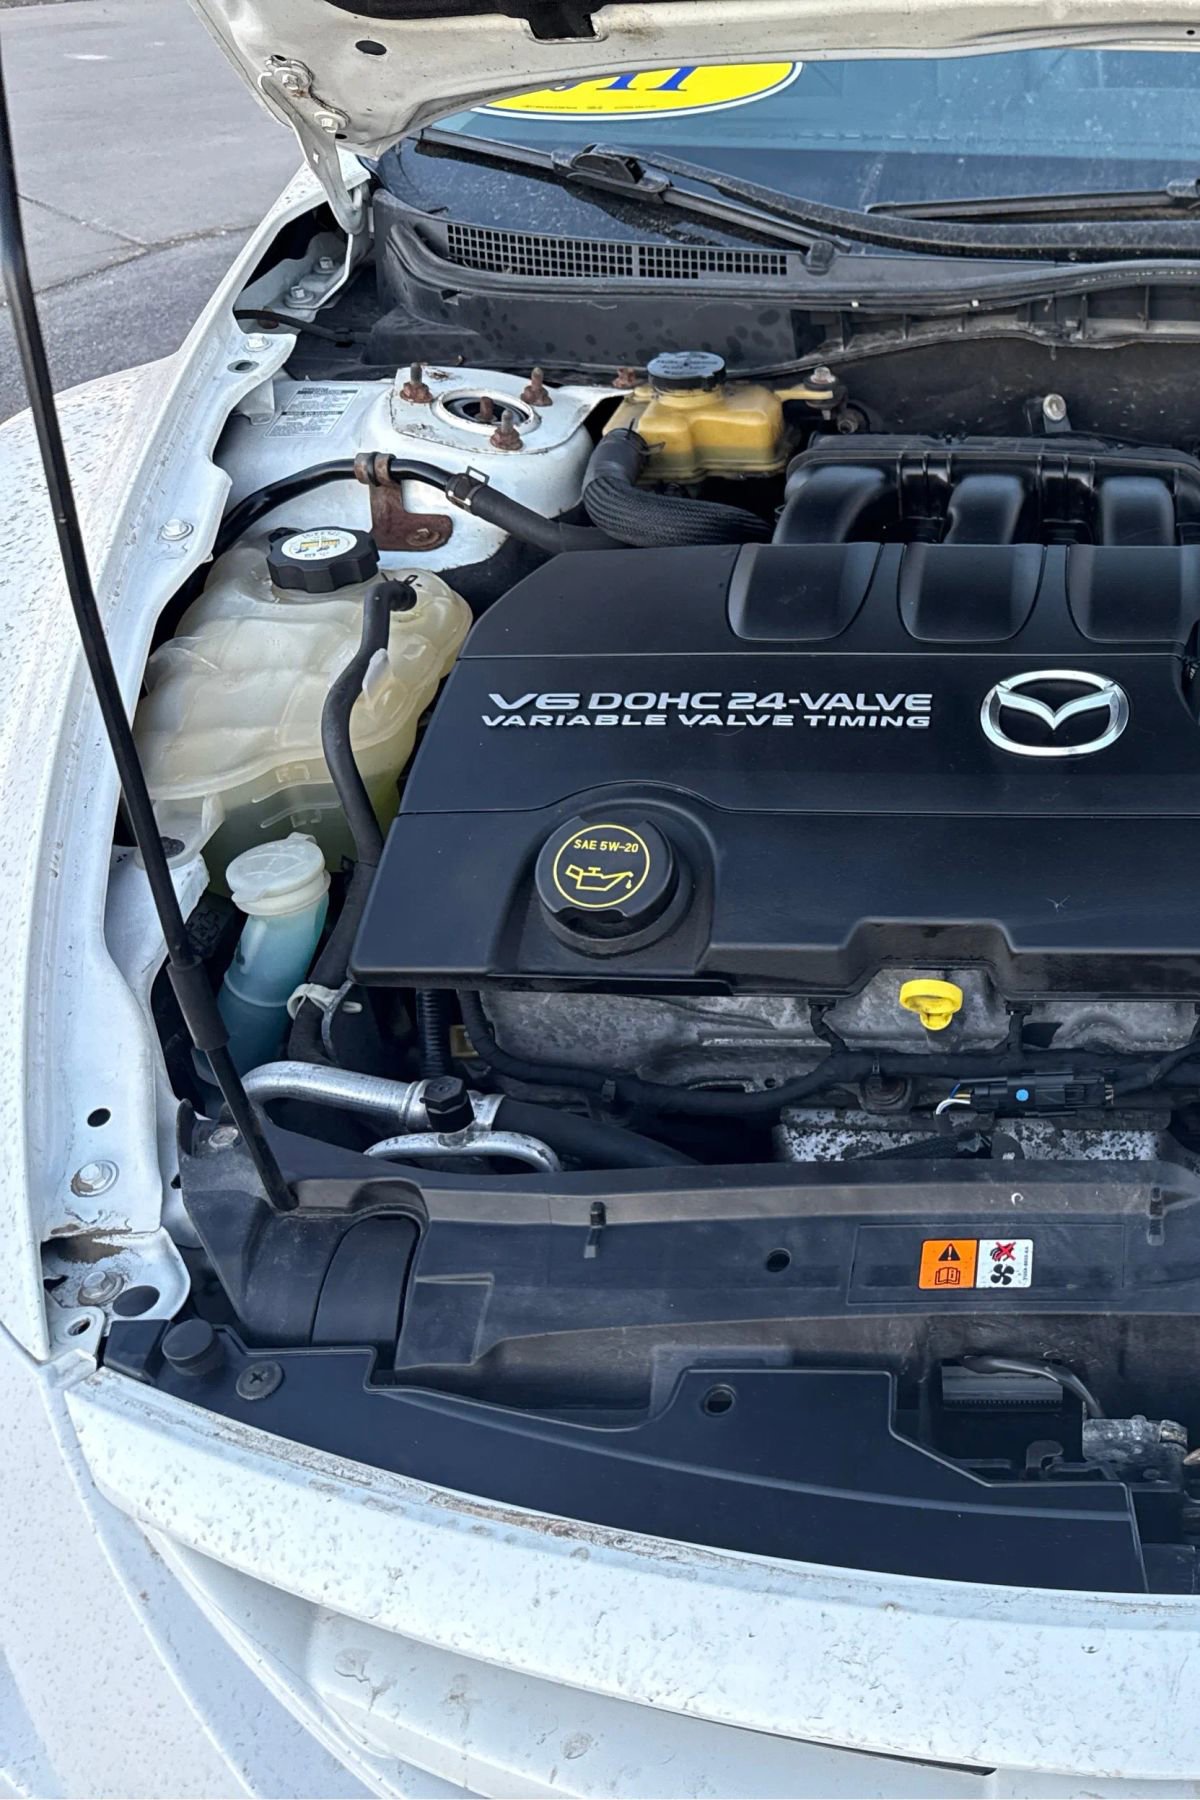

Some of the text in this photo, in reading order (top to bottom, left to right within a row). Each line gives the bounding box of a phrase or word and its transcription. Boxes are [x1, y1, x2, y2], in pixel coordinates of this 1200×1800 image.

[488, 692, 932, 711] V6 DOHC 24-VALVE
[481, 714, 931, 728] VARIABLE VALVE TIMING
[573, 839, 639, 852] SAE 5W-20
